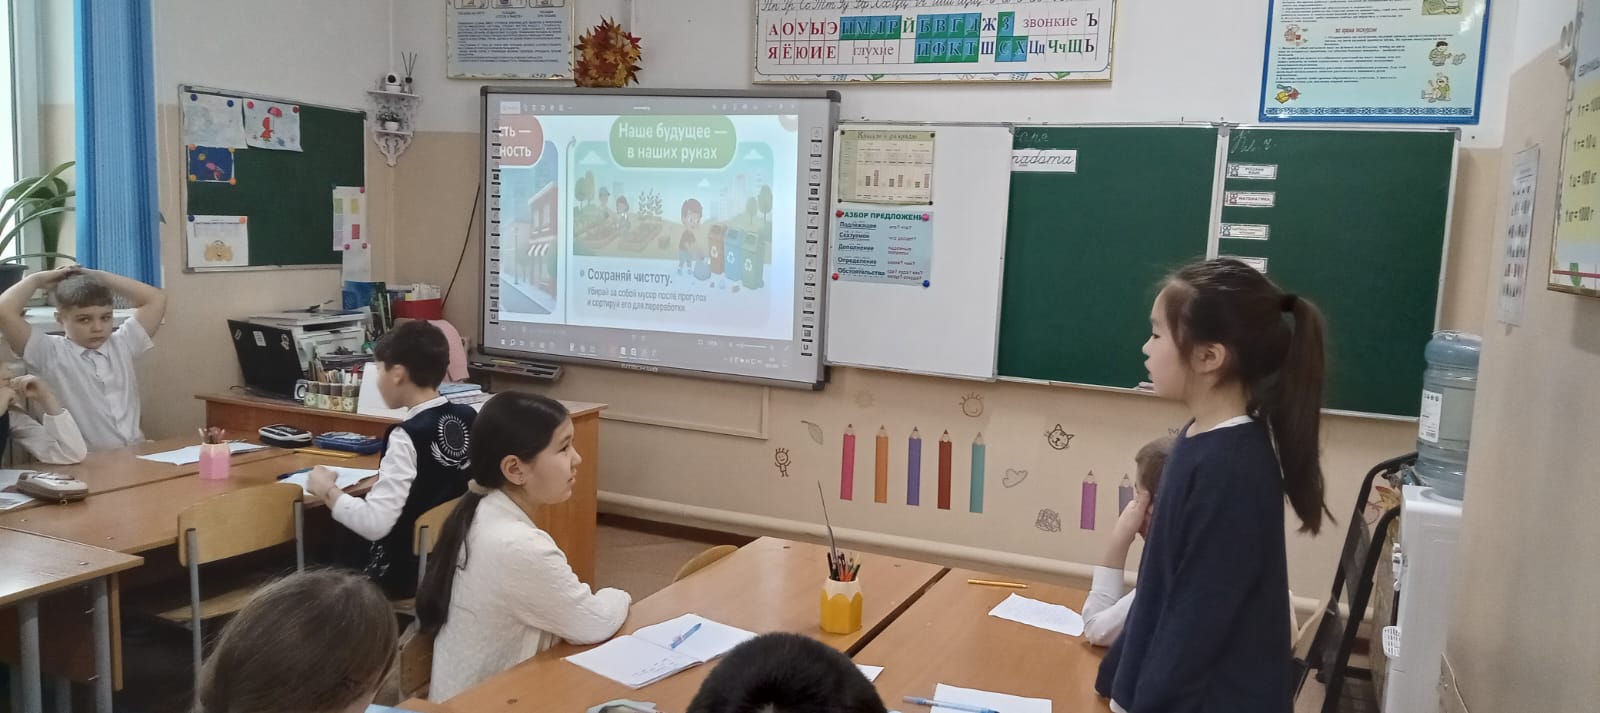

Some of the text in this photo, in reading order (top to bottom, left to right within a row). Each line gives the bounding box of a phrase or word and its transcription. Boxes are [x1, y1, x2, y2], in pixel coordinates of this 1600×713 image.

[1023, 18, 1077, 29] звонкие
[853, 46, 894, 59] глухие
[618, 121, 653, 139] Наше
[656, 122, 712, 142] будущее
[627, 147, 718, 164] в наших руках
[842, 211, 869, 219] АЗБОР
[588, 268, 673, 287] Сохраняй чистоту.
[618, 288, 637, 298] собой
